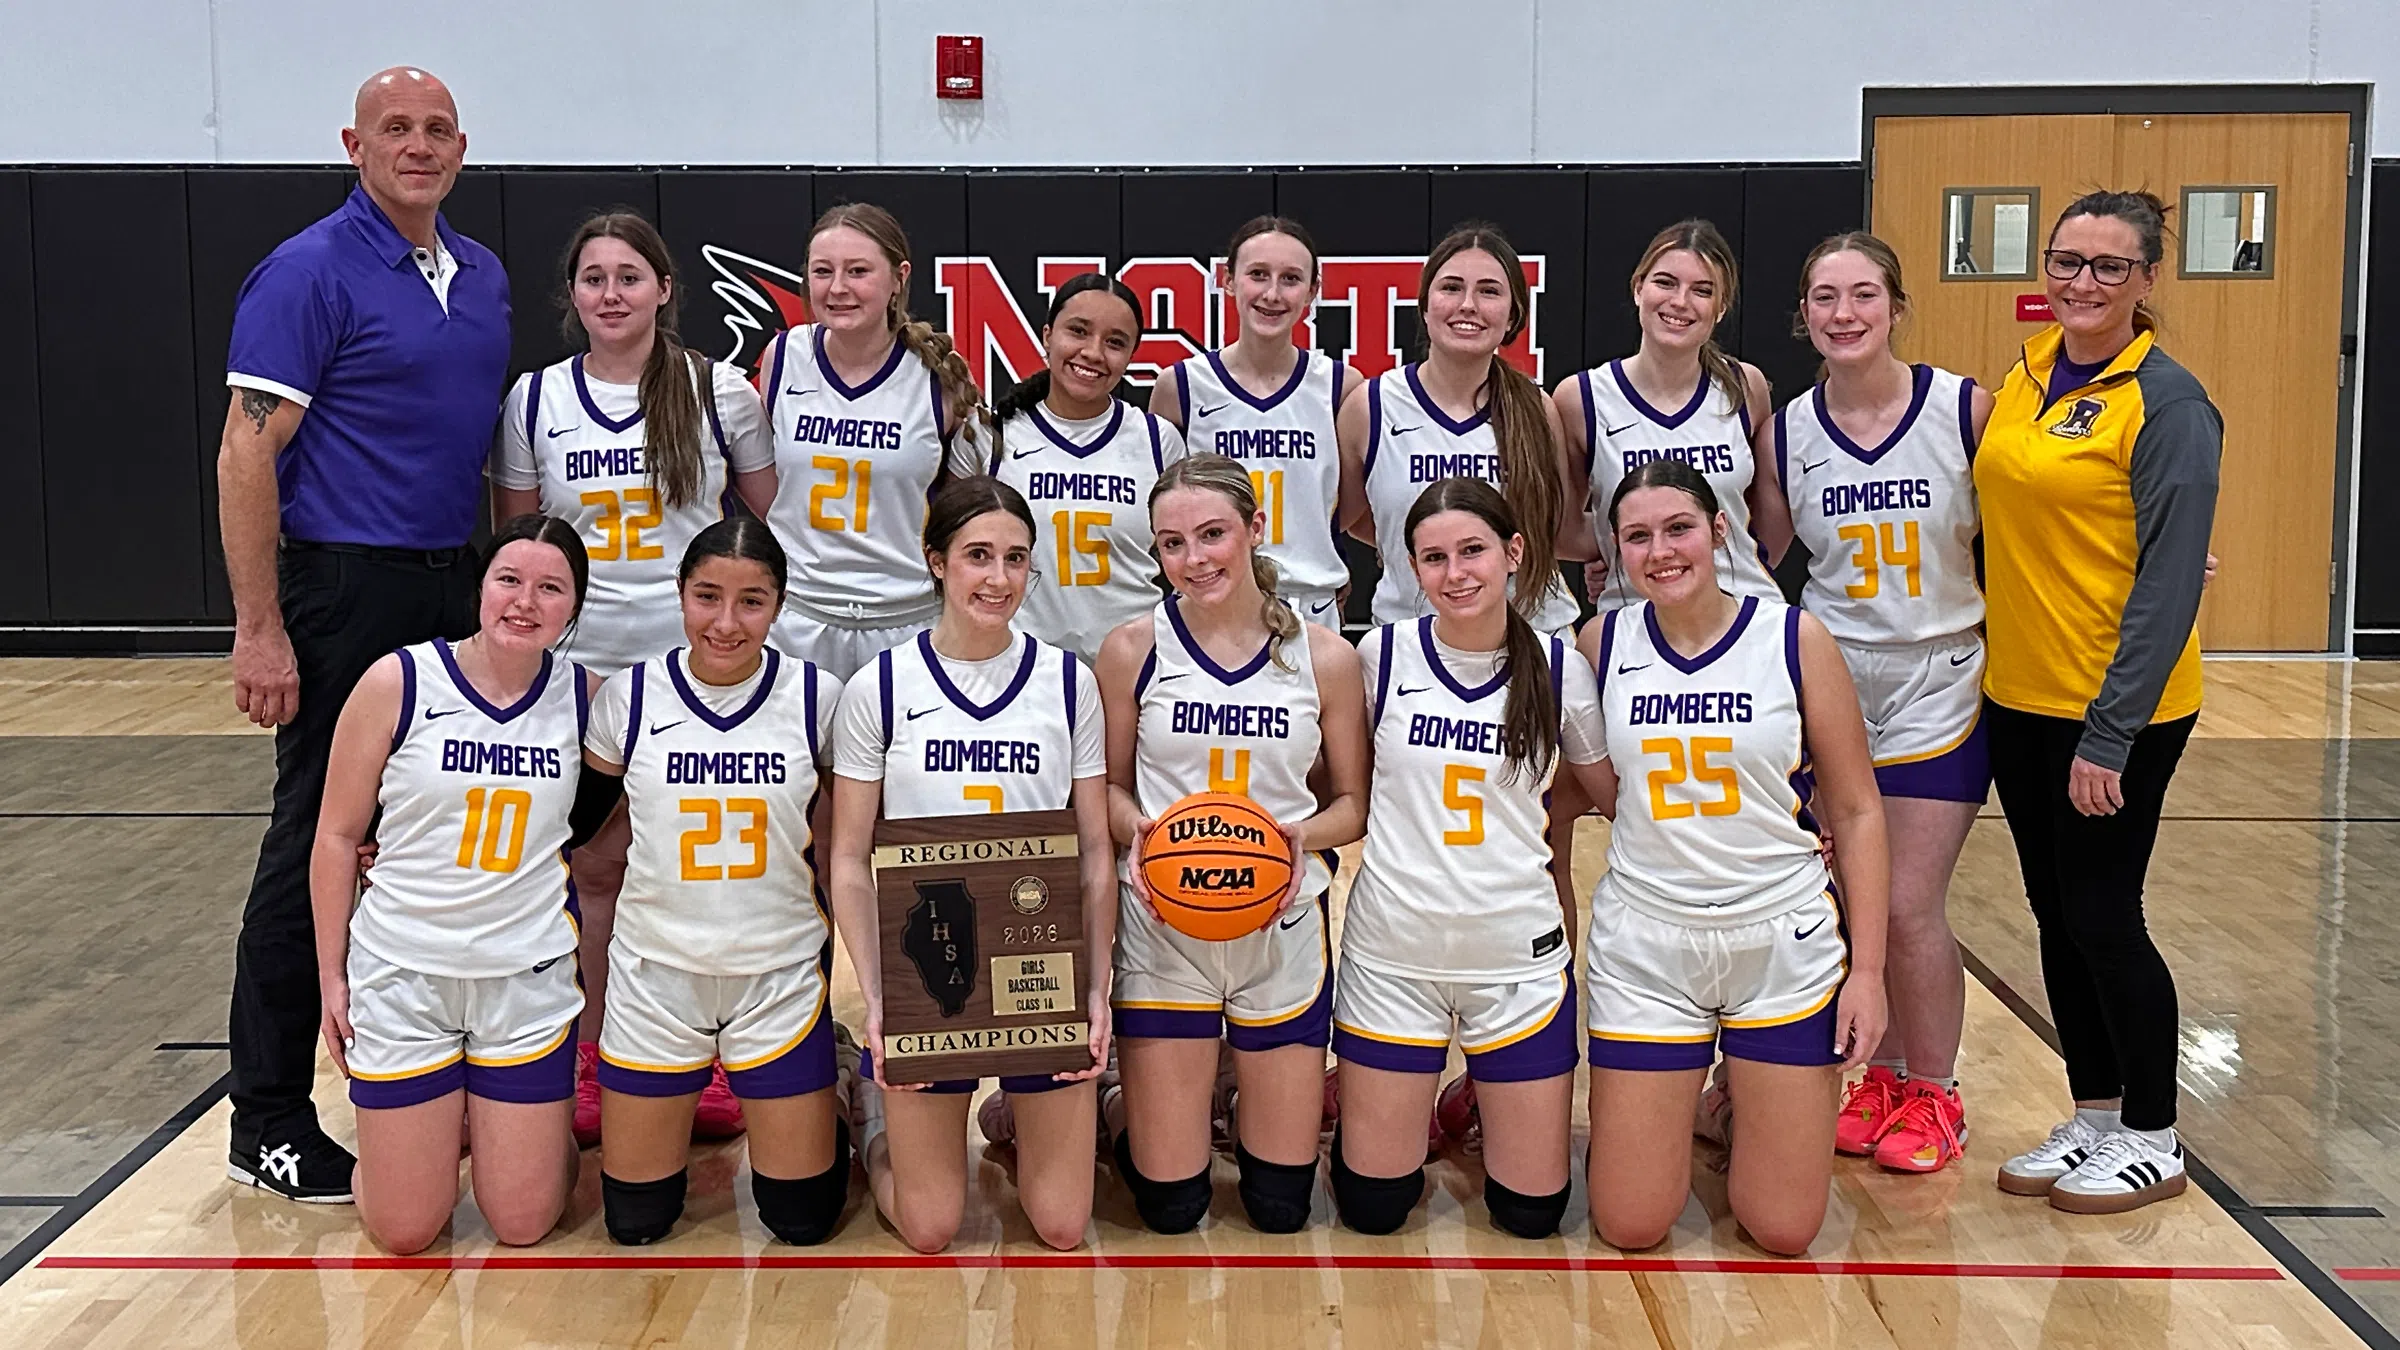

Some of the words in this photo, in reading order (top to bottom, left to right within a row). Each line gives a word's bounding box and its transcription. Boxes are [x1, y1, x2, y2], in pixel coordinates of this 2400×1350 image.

[793, 414, 901, 450] BOMBERS
[1214, 429, 1316, 459] BOMBERS
[566, 447, 650, 481] BOMBE
[1410, 453, 1507, 483] BOMBER
[809, 455, 872, 533] 21
[1029, 472, 1136, 505] BOMBERS
[1822, 479, 1931, 517] BOMBERS
[580, 487, 665, 561] 32
[1052, 510, 1112, 587] 15
[1837, 521, 1922, 598] 34
[1172, 701, 1289, 739] BOMBERS
[1629, 692, 1752, 725] BOMBERS
[1408, 713, 1520, 758] BOMBER
[441, 739, 561, 779] BOMBERS
[666, 752, 786, 784] BOMBERS
[925, 739, 1040, 775] BOMBERS
[1641, 736, 1741, 820] 25
[1443, 764, 1487, 845] 5
[456, 787, 532, 873] 10
[679, 798, 768, 881] 23
[1167, 815, 1266, 847] Wilson
[900, 839, 1054, 864] REGIONAL
[1179, 866, 1255, 890] NCAA
[1003, 924, 1058, 944] 2026
[1008, 977, 1060, 993] BASKETBALL
[1021, 960, 1045, 975] GIRLS
[1017, 999, 1040, 1012] CLASS
[1044, 998, 1054, 1010] 1A
[896, 1025, 1077, 1054] CHAMPIONS
